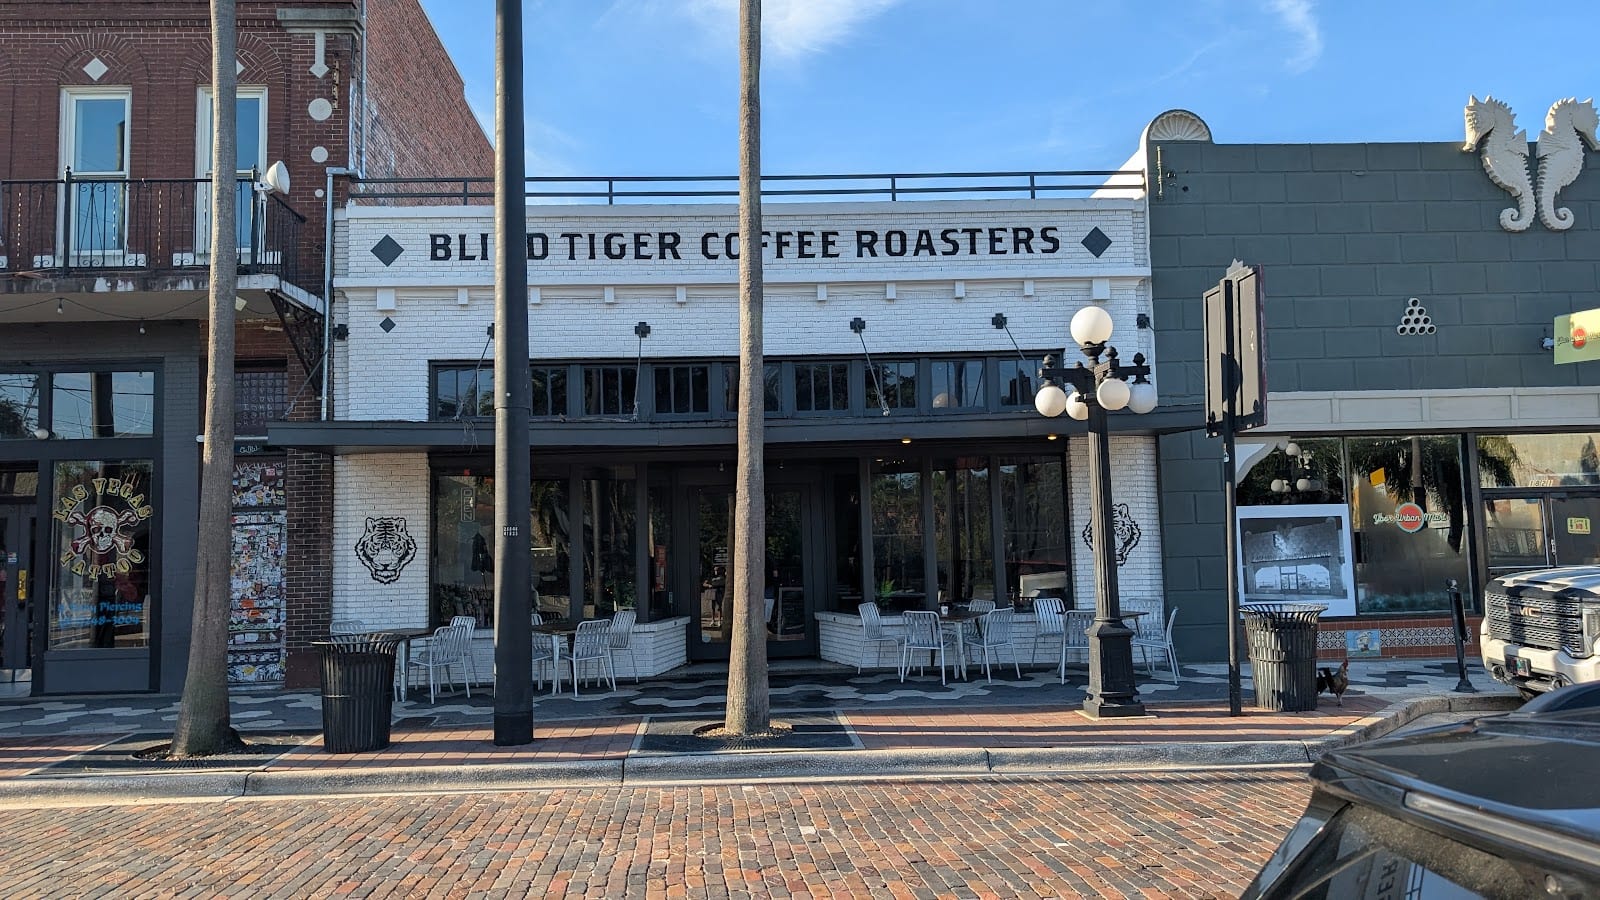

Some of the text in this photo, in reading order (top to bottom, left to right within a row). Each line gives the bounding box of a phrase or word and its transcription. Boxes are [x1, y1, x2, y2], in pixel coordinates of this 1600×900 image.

[429, 233, 549, 261] BLID
[560, 232, 682, 260] TIGER
[856, 226, 1061, 258] ROASTERS
[53, 477, 153, 522] LAS VEGAS
[1395, 513, 1422, 522] Urban
[1423, 512, 1449, 521] Mart
[60, 548, 144, 582] TATTOO
